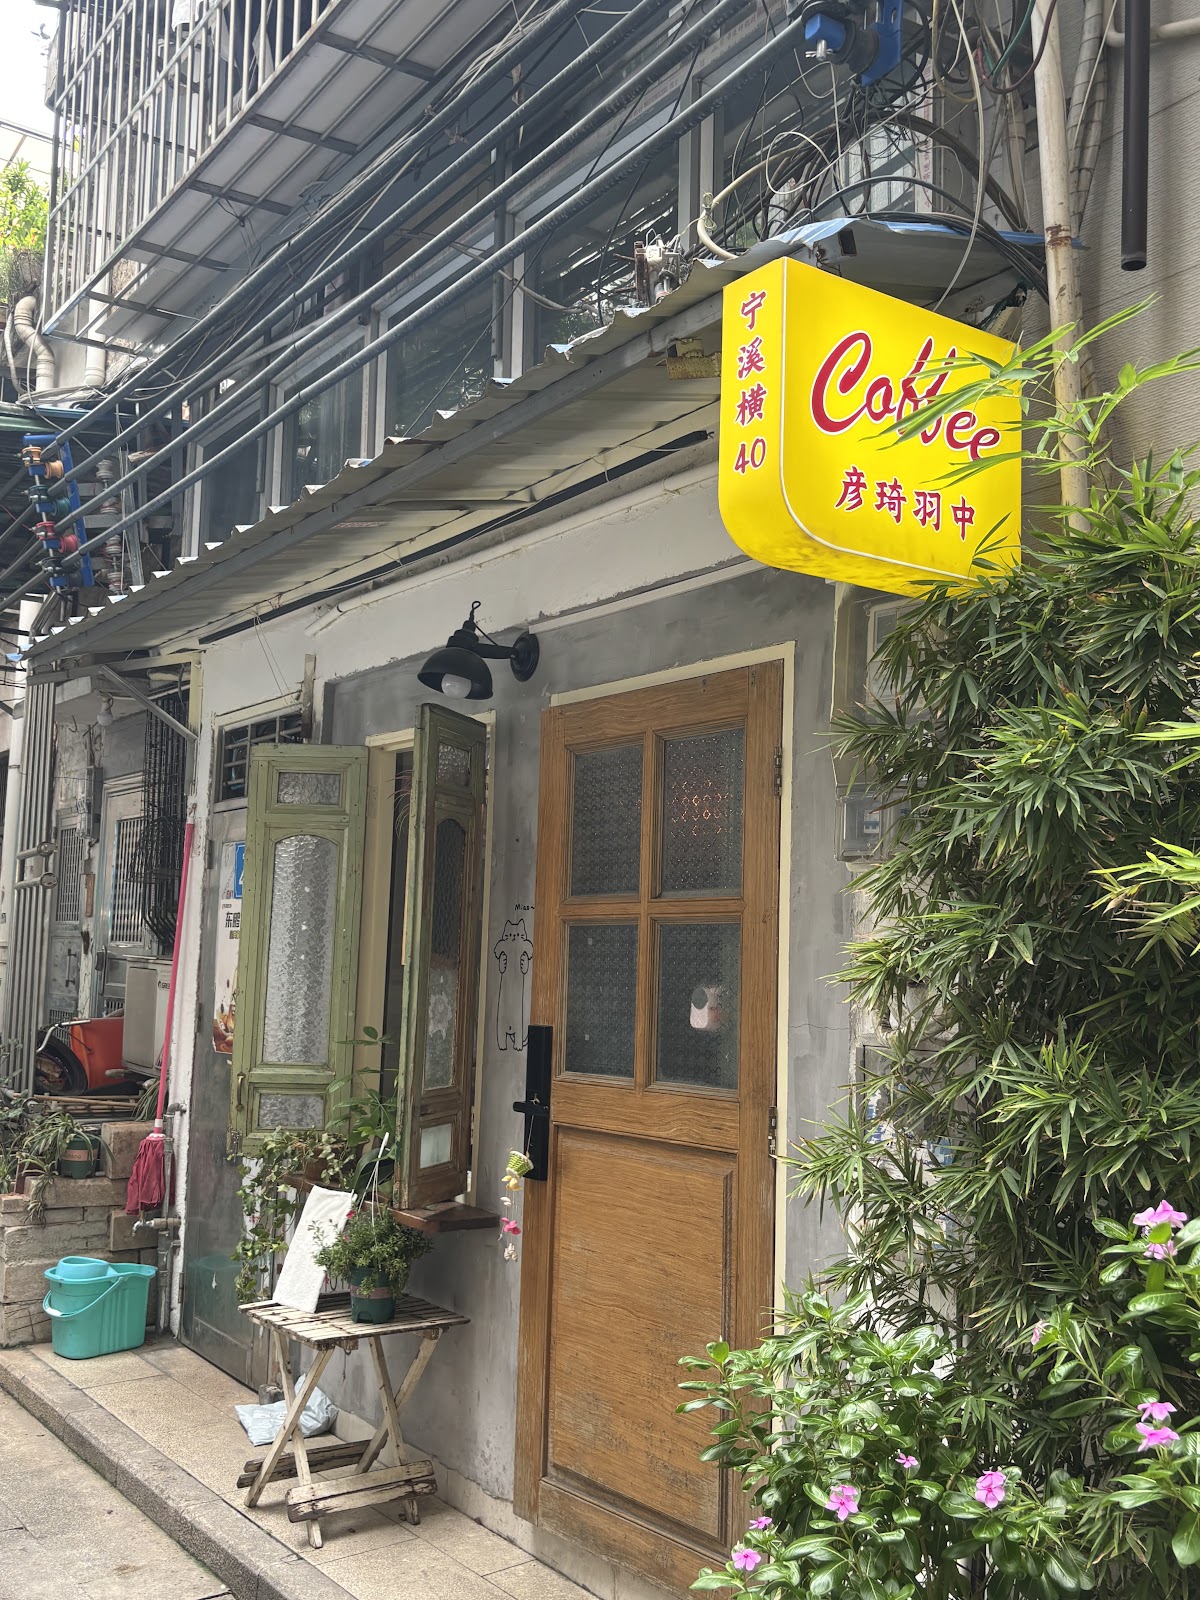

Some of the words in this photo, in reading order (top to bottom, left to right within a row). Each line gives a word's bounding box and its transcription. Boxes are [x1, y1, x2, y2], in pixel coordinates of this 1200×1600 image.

[811, 332, 1000, 460] Coffee
[836, 467, 975, 539] 彦琦羽中
